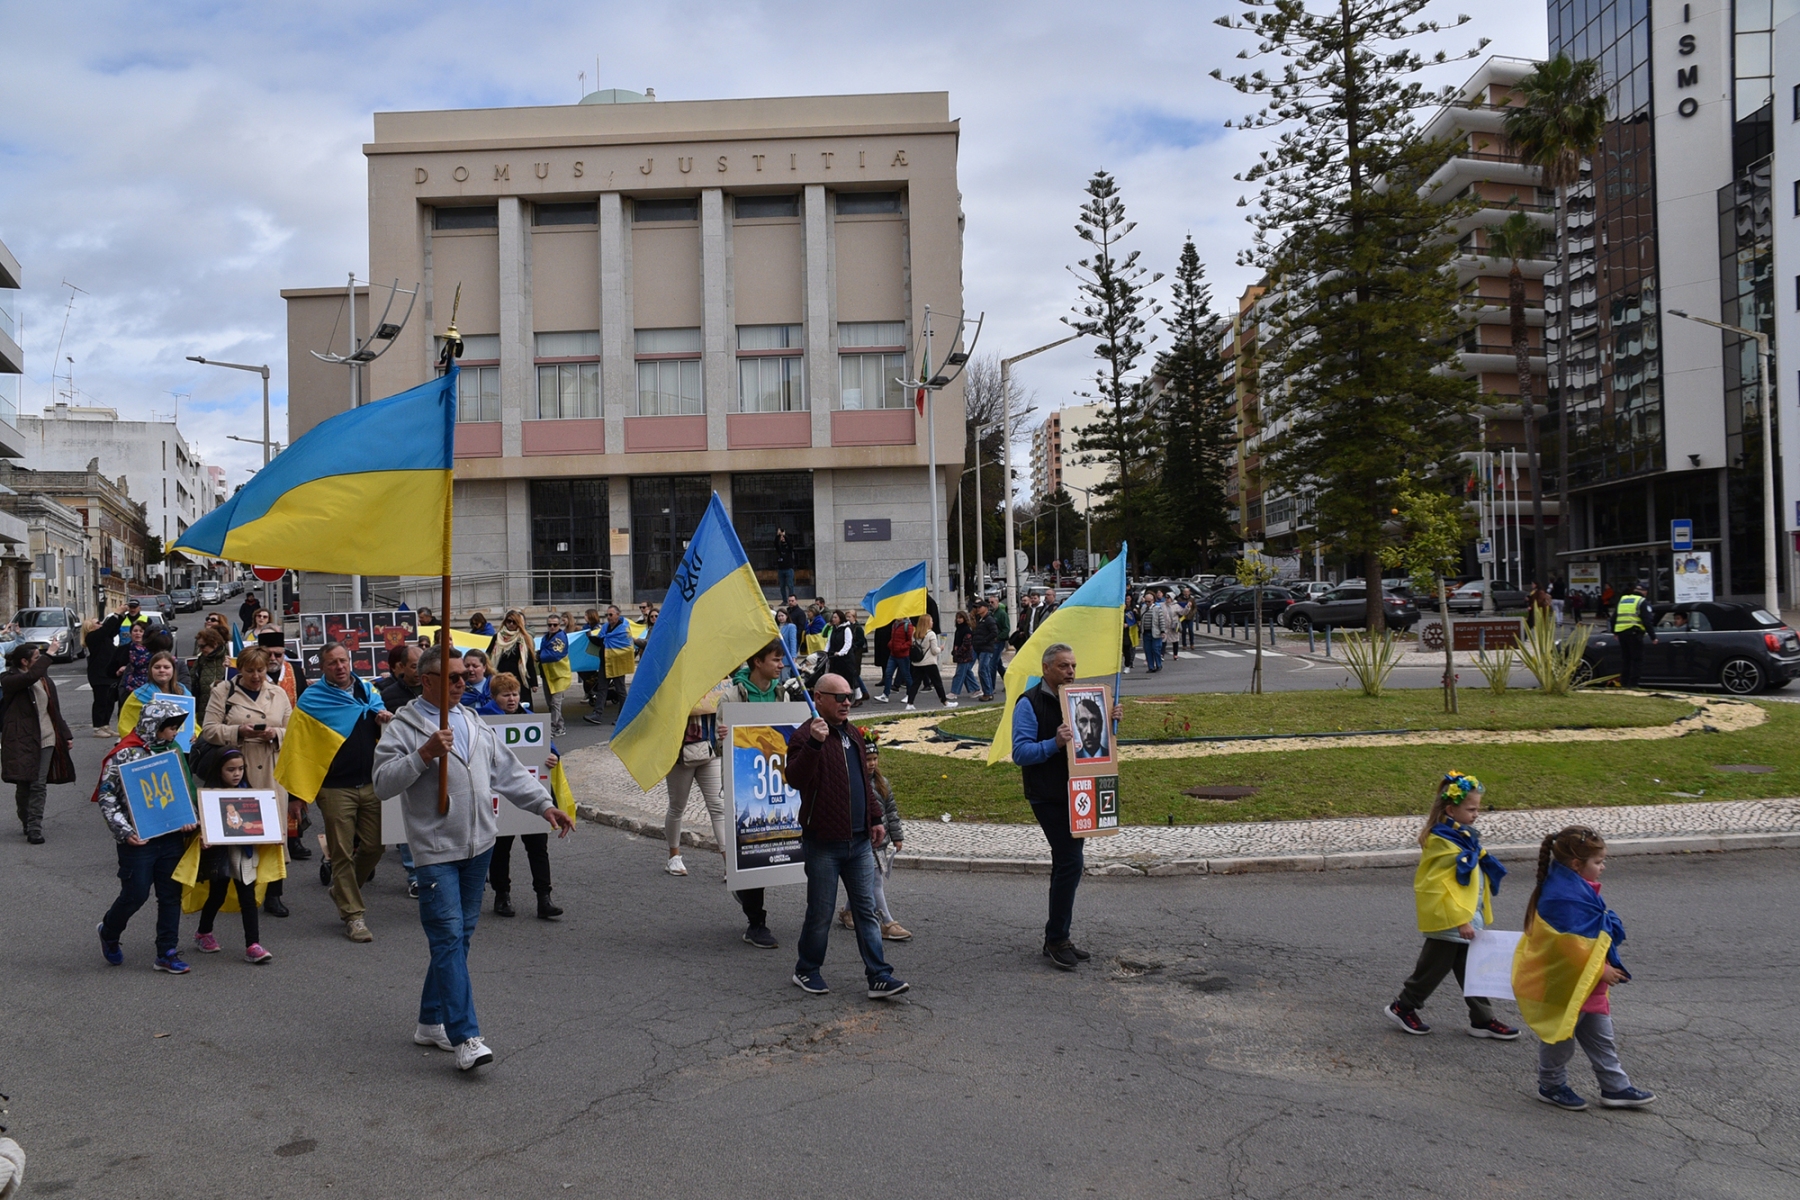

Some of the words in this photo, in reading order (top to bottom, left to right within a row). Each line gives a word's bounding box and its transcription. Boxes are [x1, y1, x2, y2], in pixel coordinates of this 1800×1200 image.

[1678, 3, 1698, 118] ISMO
[415, 161, 584, 185] DOMUS
[1072, 779, 1092, 791] NEVER
[1099, 778, 1115, 789] 2022
[1076, 818, 1092, 830] 1939
[1098, 816, 1117, 828] AGAIN
